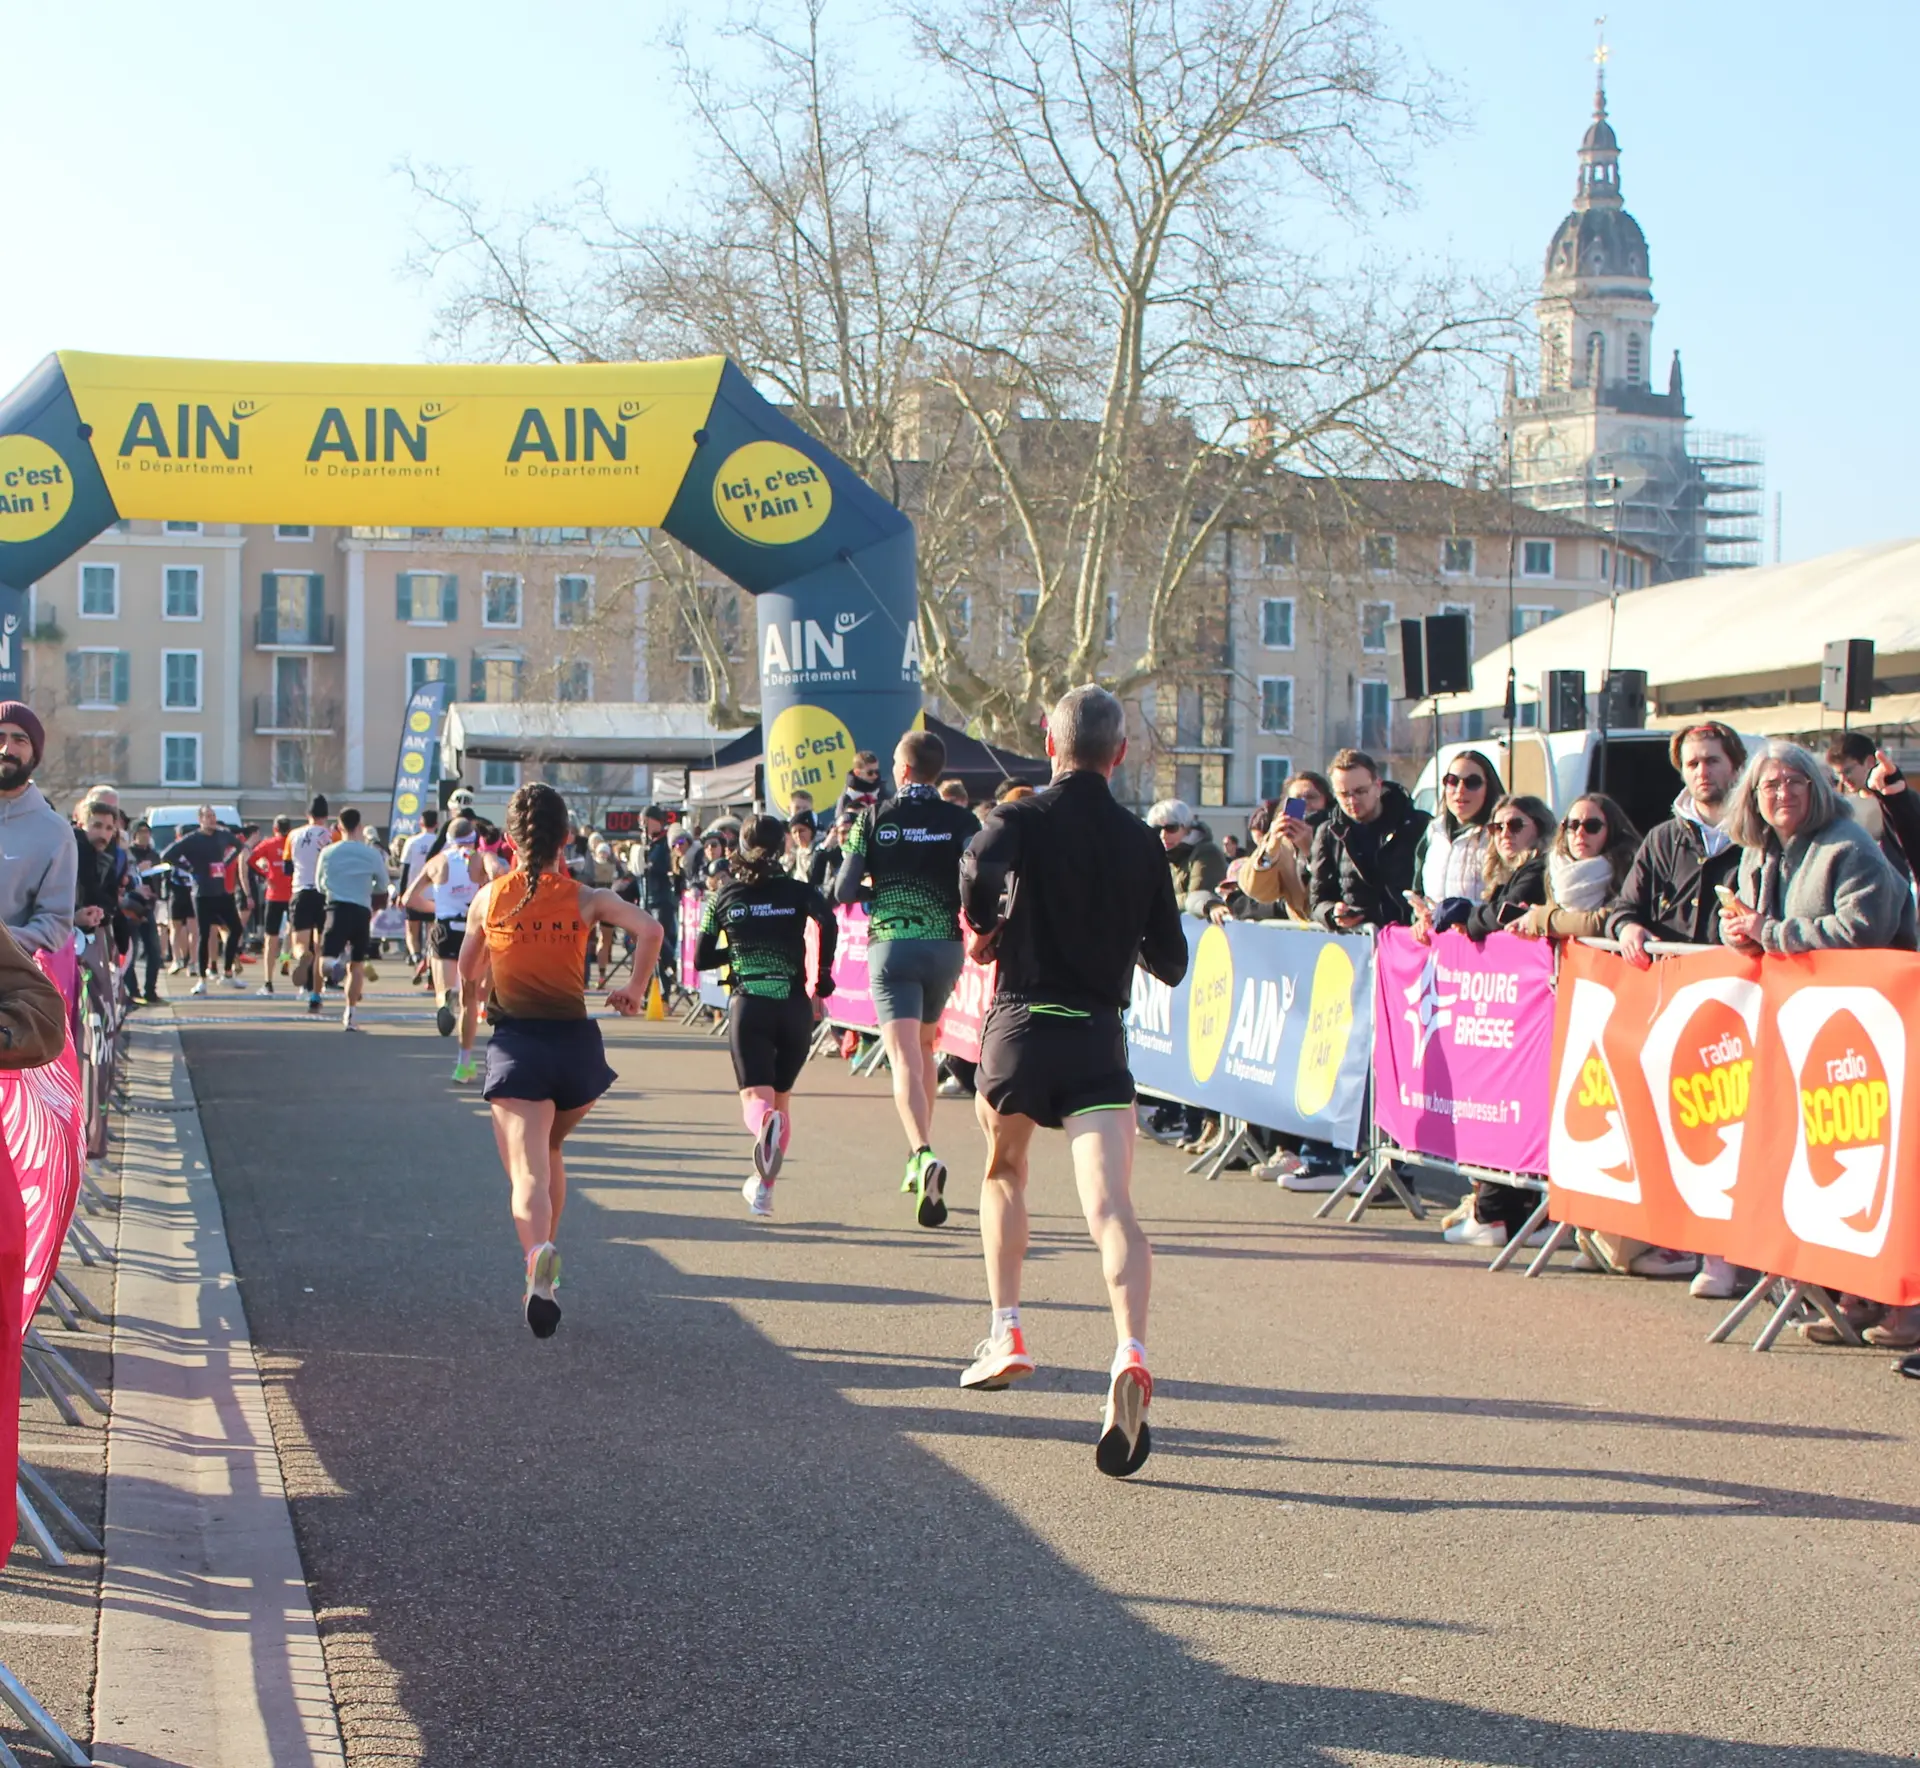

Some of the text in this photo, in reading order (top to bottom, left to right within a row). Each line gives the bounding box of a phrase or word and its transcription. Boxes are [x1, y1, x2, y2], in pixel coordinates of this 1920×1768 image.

[239, 400, 255, 411] 01
[425, 402, 441, 413] 01
[623, 401, 640, 412] 01
[118, 403, 240, 460] AIN
[306, 408, 427, 462] AIN
[506, 408, 626, 462] AIN
[5, 465, 63, 487] c'est
[116, 460, 254, 475] le Département
[304, 464, 441, 478] le Département
[504, 464, 640, 478] le Département
[722, 466, 819, 501] Ici, c'est
[743, 497, 798, 522] l'Ain
[840, 613, 856, 624] 01
[763, 620, 845, 674] AIN
[771, 669, 857, 686] Département
[412, 694, 433, 708] AIN
[404, 736, 427, 749] AIN
[771, 731, 845, 769] Ici, c'est
[398, 778, 421, 792] AIN
[781, 766, 822, 792] l'Ain
[880, 831, 897, 840] TDR
[903, 828, 927, 836] TERRE
[912, 833, 952, 842] RUNNING
[750, 903, 772, 912] TERRE
[760, 908, 796, 917] RUNNING
[1460, 971, 1519, 1004] BOURG
[1126, 964, 1172, 1035] AIN
[1228, 977, 1286, 1065] AIN
[1699, 1032, 1742, 1069] radio
[1825, 1047, 1867, 1083] radio
[1411, 1090, 1508, 1125] www.bourgenbresse.fr
[1801, 1080, 1888, 1147] SCOOP
